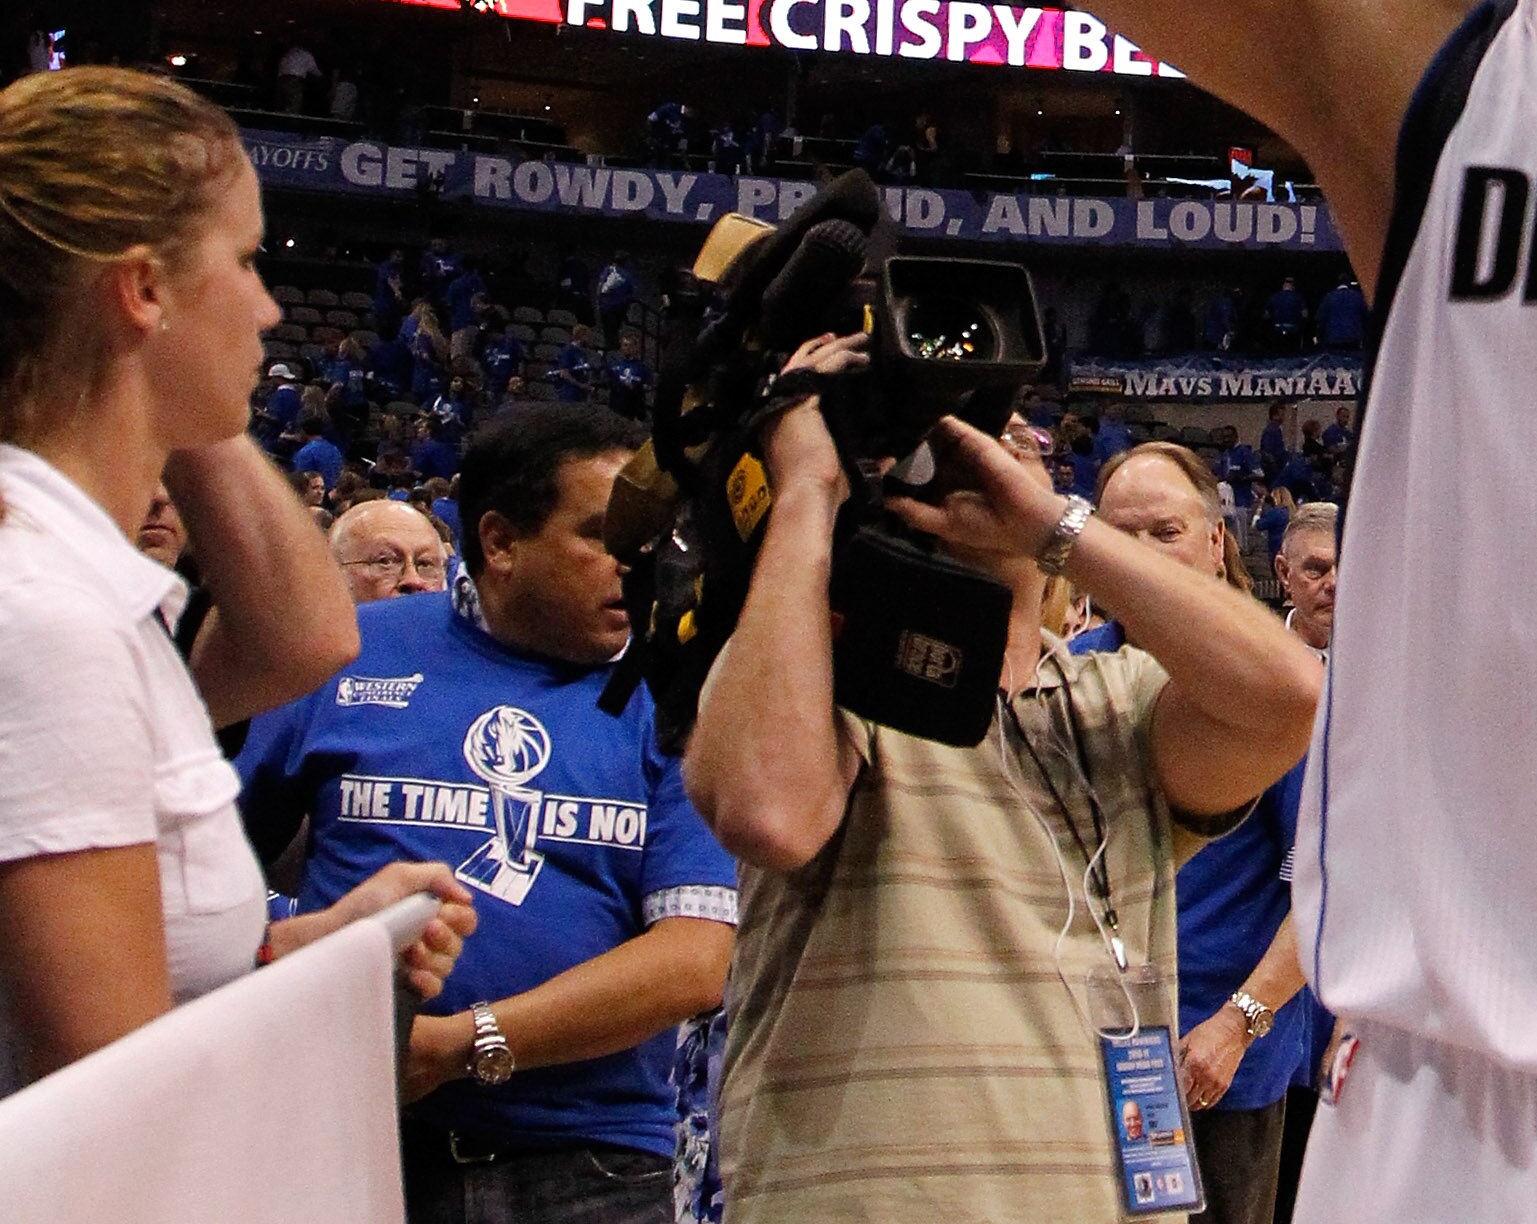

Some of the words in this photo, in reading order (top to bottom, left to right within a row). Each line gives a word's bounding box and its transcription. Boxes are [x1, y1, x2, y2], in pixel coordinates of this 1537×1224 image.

[340, 142, 454, 192] GET
[473, 157, 716, 219] ROWDY,
[982, 194, 1115, 239] AND
[1136, 200, 1317, 243] LOUD!
[339, 779, 391, 819] THE
[402, 784, 488, 826] TIME
[543, 800, 578, 839] IS
[589, 806, 647, 847] NO
